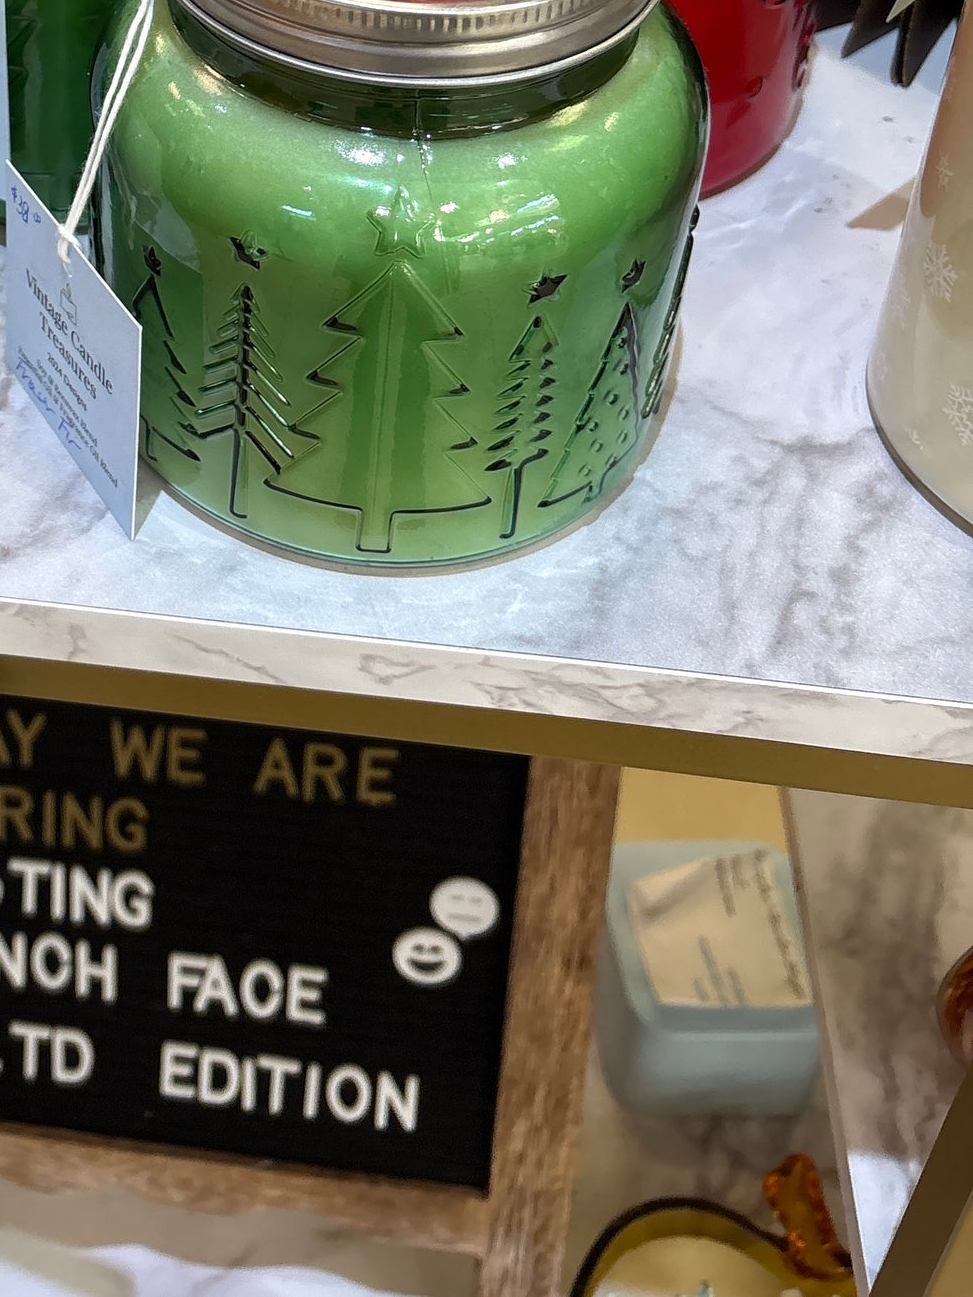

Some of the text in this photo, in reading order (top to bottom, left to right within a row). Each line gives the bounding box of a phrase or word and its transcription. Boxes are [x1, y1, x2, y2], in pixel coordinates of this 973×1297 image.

[25, 266, 113, 395] Vintage Candle
[39, 311, 97, 399] Treasures
[109, 716, 211, 786] WE
[253, 737, 402, 806] ARE
[165, 948, 329, 1027] FACE
[157, 1037, 422, 1134] EDITION
